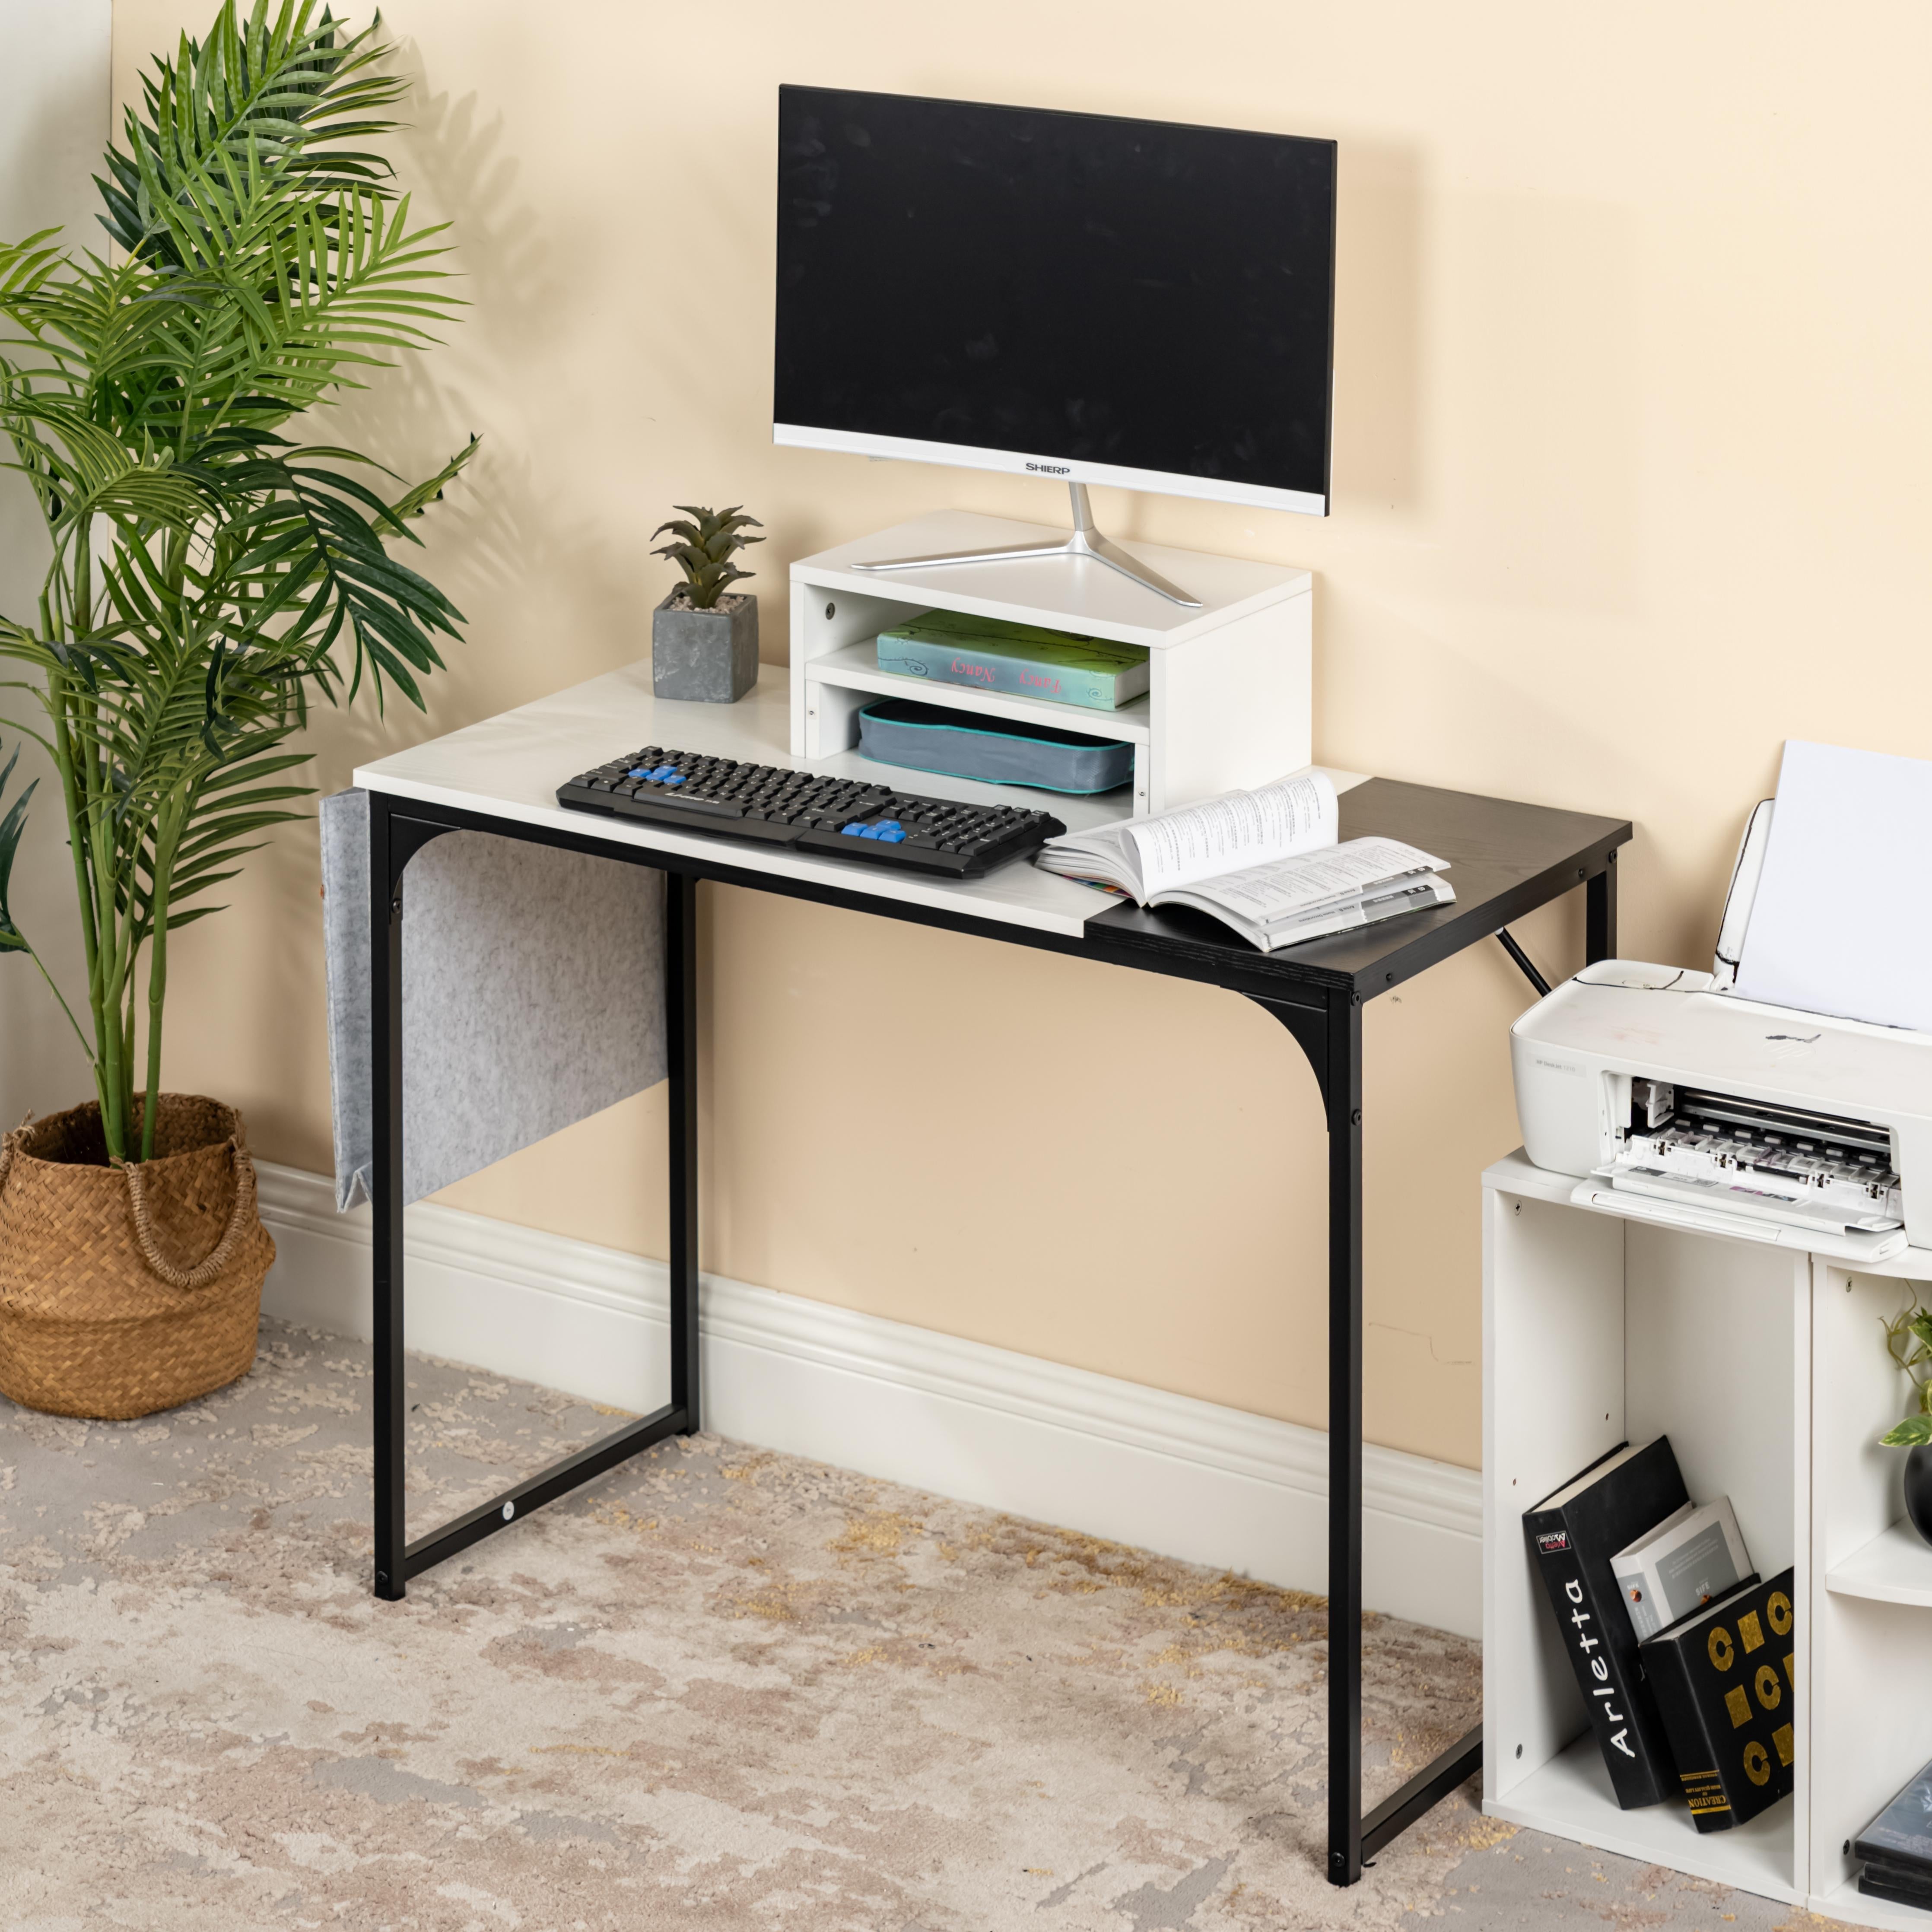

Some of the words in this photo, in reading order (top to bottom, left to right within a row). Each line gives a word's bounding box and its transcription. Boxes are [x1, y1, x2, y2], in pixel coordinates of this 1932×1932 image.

[1026, 463, 1070, 474] SHIERP
[951, 657, 995, 683] Nancy
[1019, 668, 1061, 693] Fancy
[1696, 1582, 1710, 1596] SIFE
[1566, 1579, 1635, 1758] Arletta
[1688, 1795, 1726, 1808] CREATION
